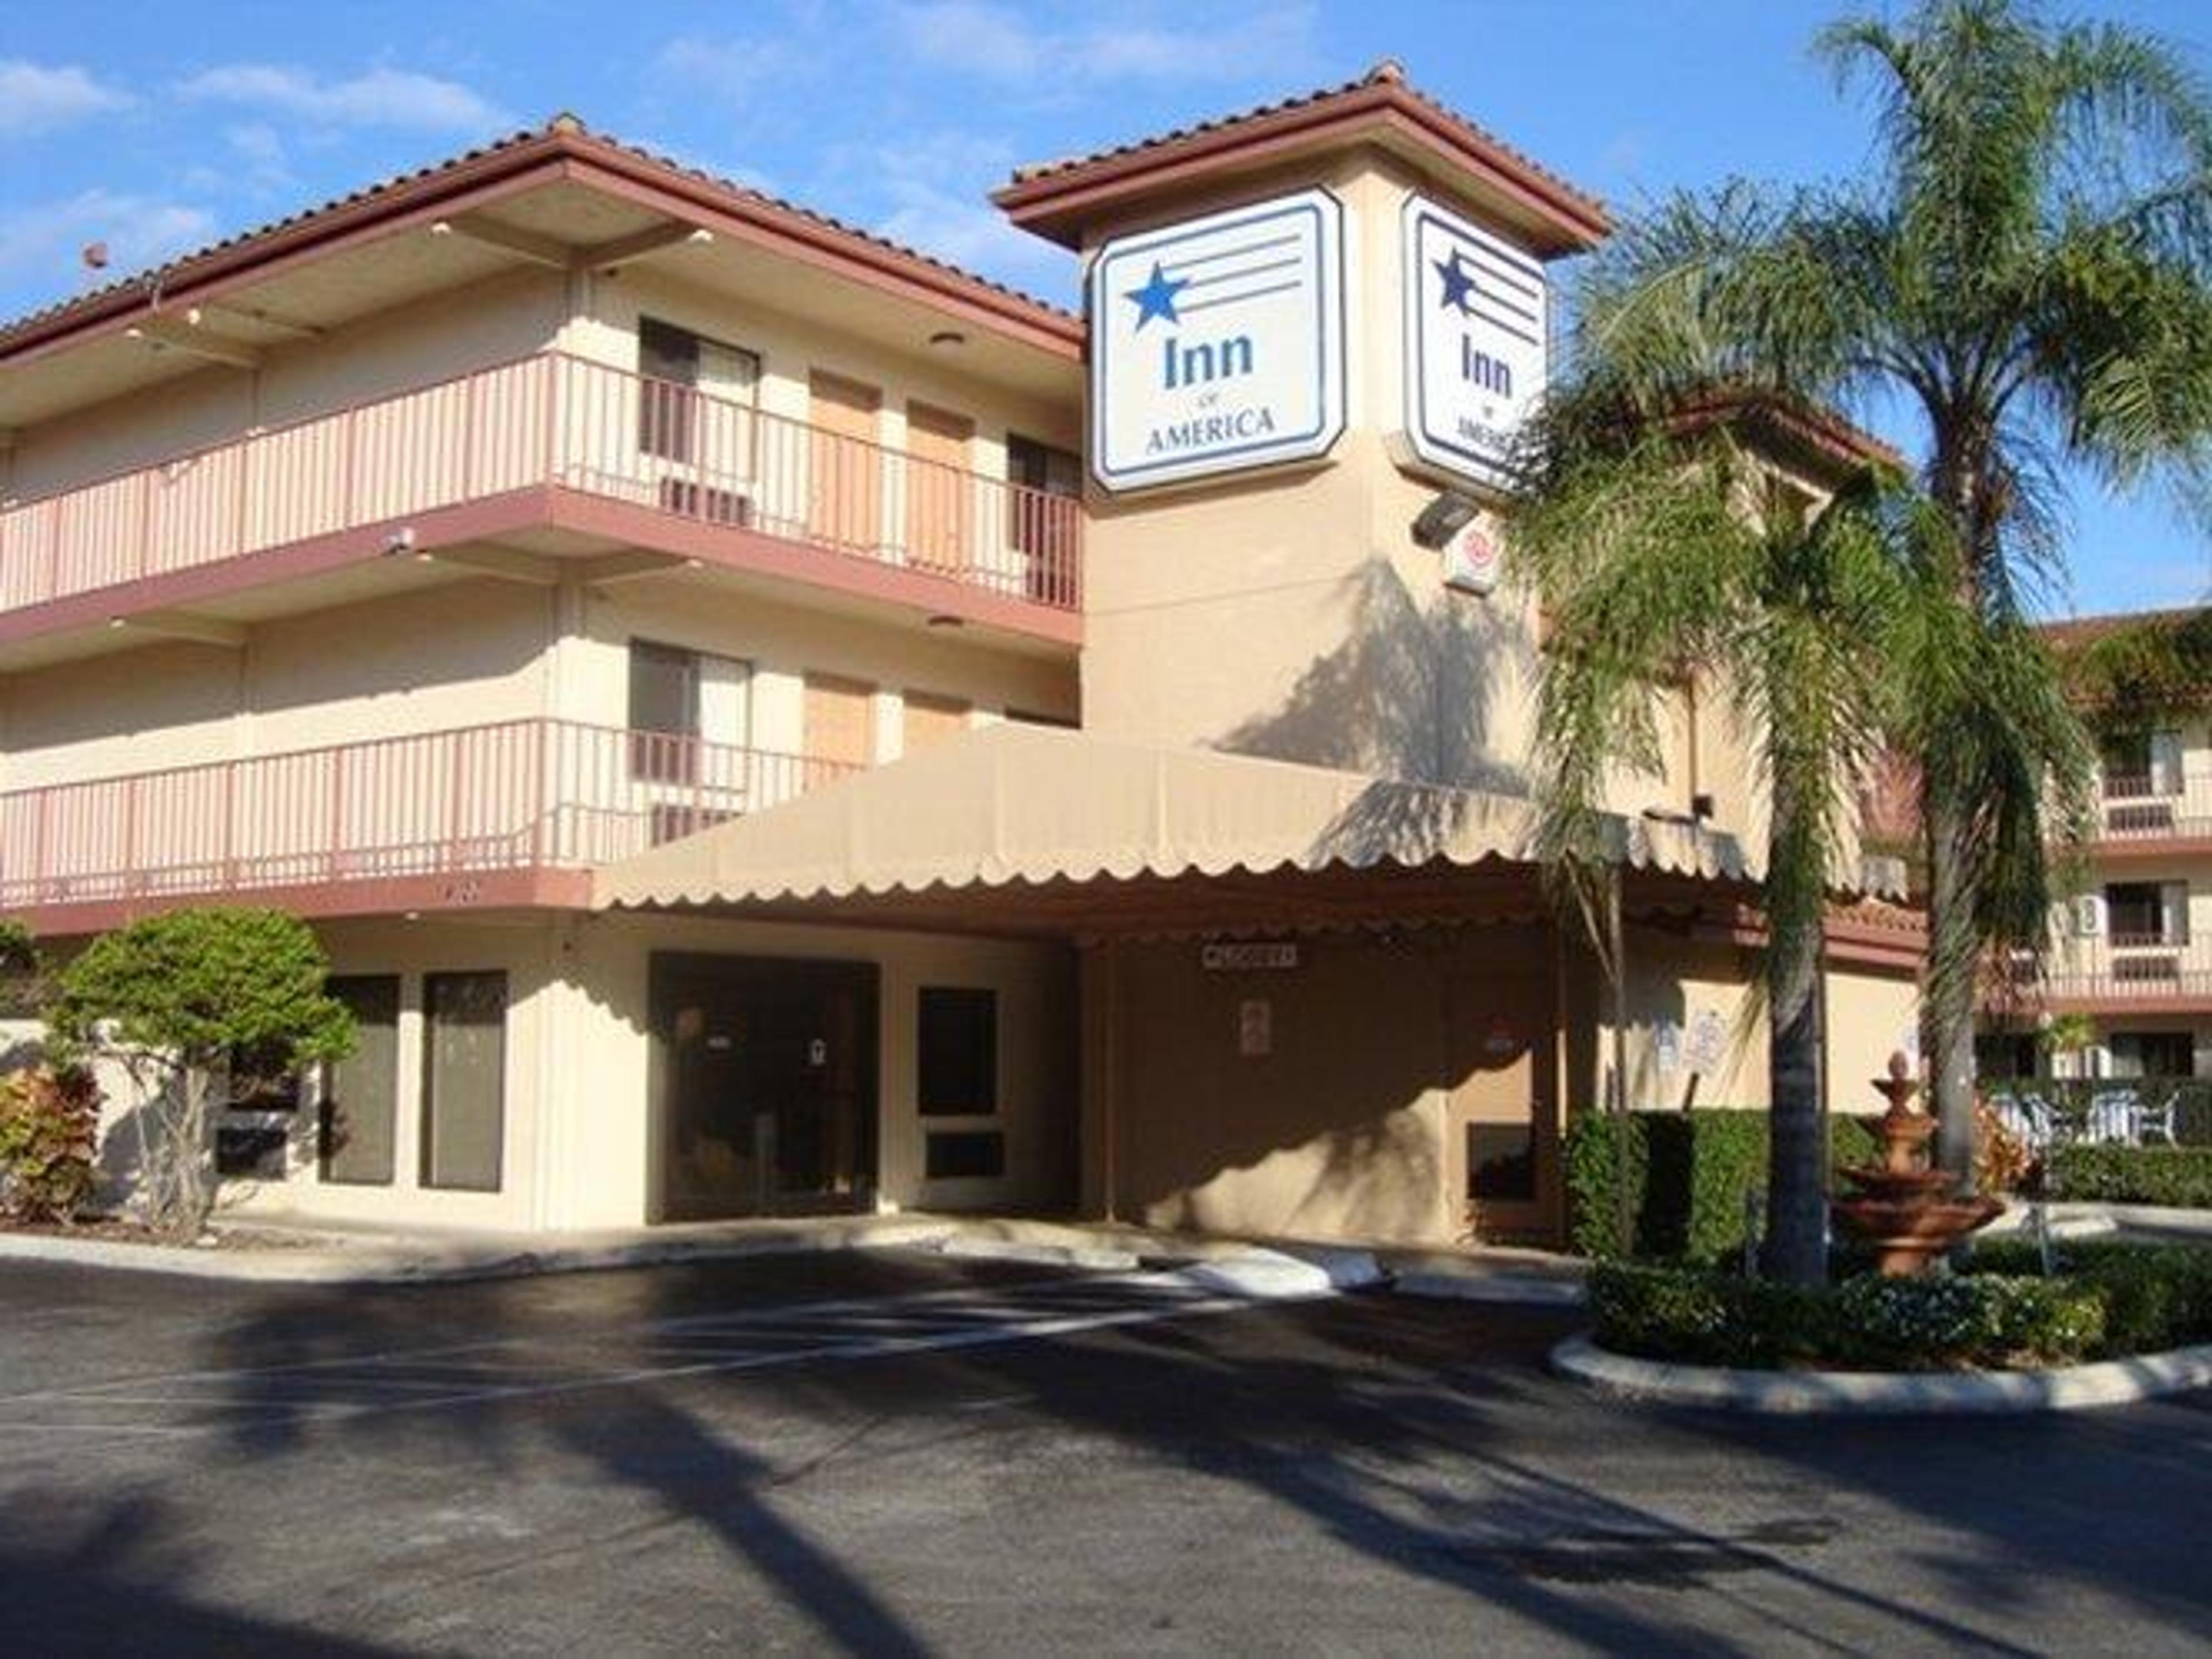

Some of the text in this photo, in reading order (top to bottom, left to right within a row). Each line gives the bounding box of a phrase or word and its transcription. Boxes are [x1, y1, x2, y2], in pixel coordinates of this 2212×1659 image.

[1165, 335, 1252, 390] Inn
[1462, 332, 1511, 399] Inn
[1145, 406, 1275, 456] AMERICA
